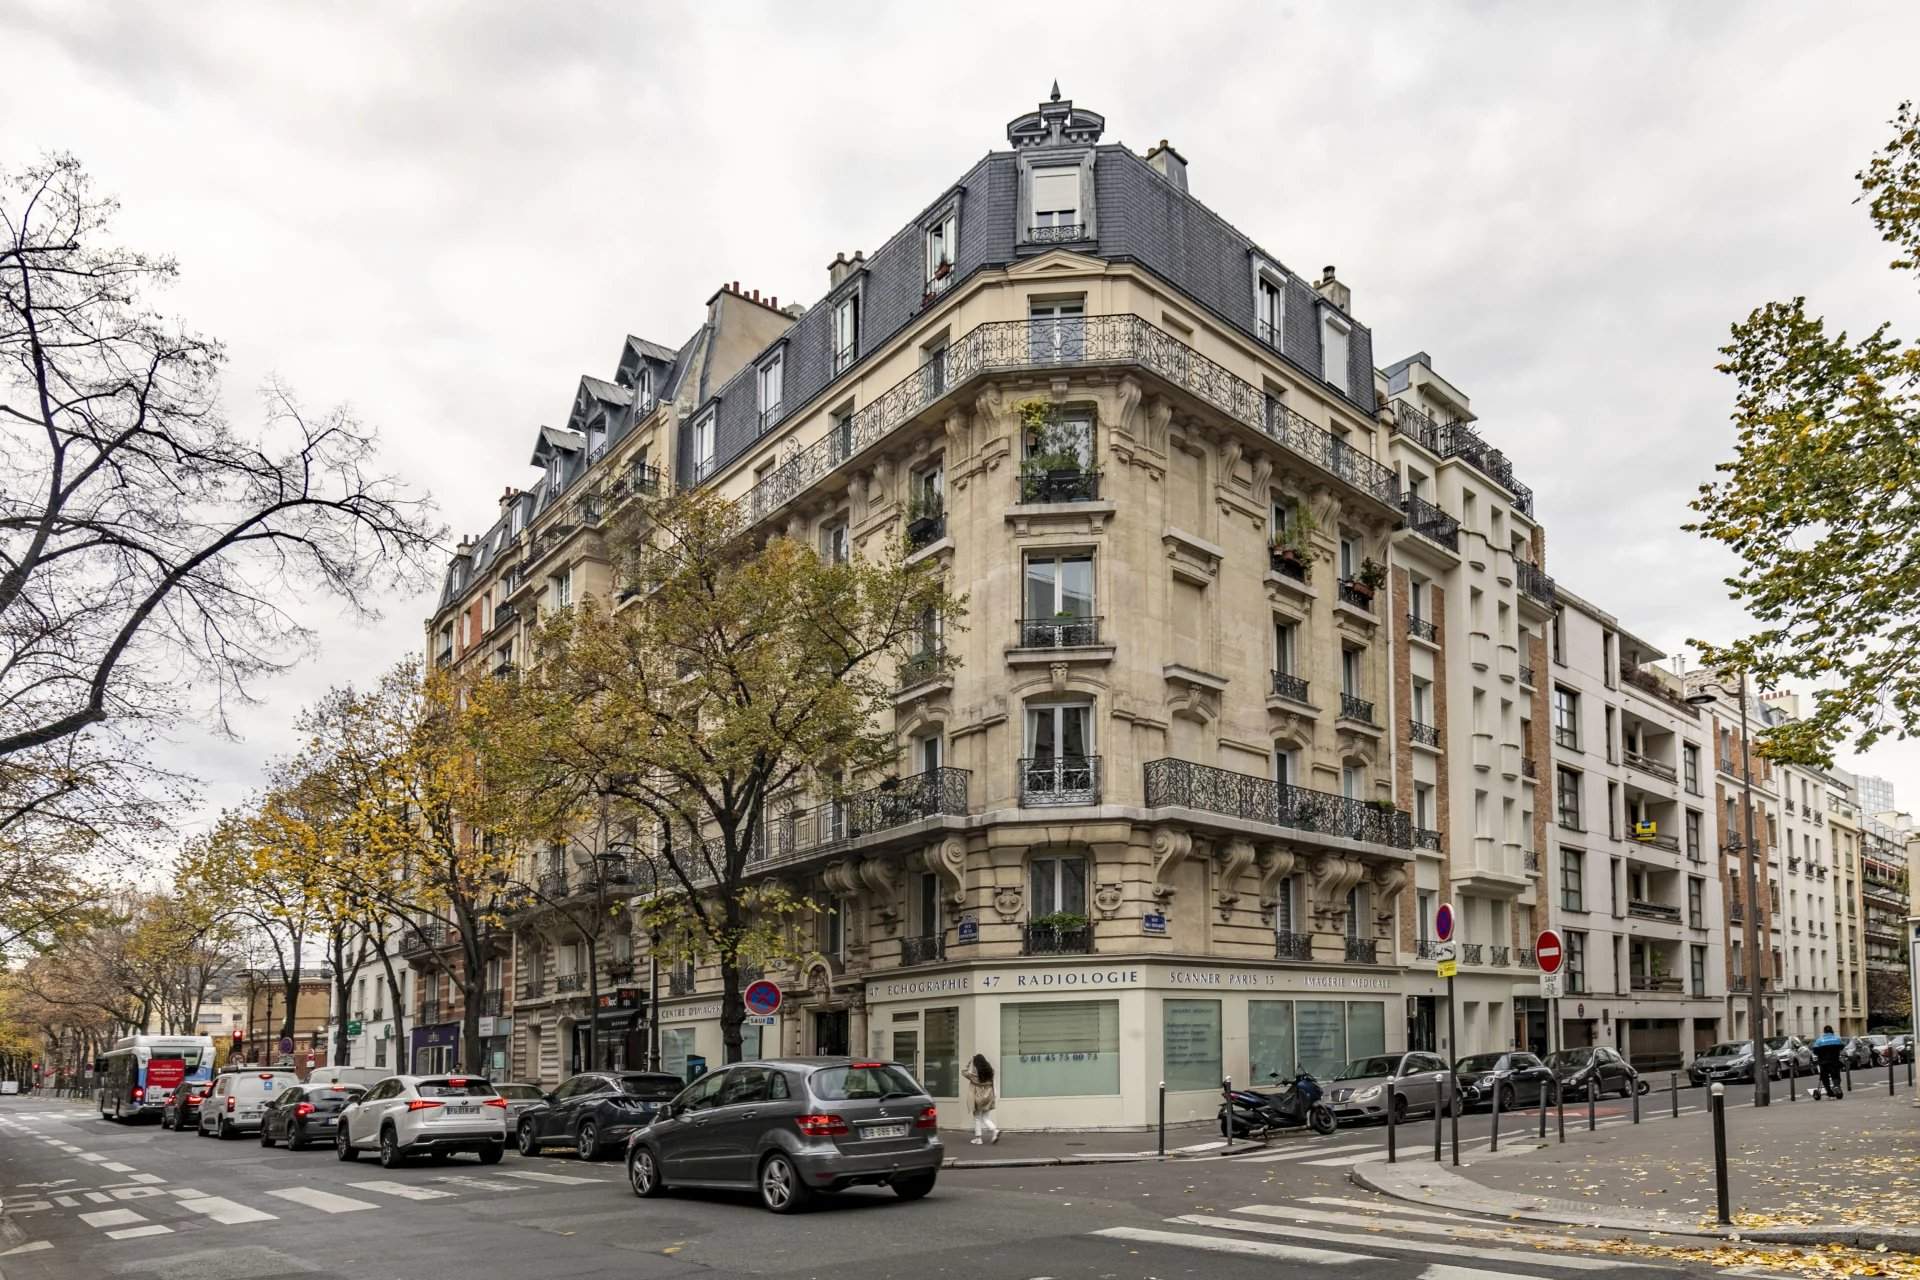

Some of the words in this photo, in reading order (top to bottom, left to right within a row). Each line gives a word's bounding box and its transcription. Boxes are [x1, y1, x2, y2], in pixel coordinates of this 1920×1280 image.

[887, 978, 969, 996] ECHOGRAPHIE
[983, 976, 1000, 987] 47
[1018, 971, 1137, 986] RADIOLOGIE
[1170, 971, 1220, 985] SCANNER
[1229, 974, 1257, 985] PARIS
[1265, 975, 1274, 985] 15
[1304, 976, 1344, 987] IMAGERIE
[661, 1007, 685, 1019] CENTRE
